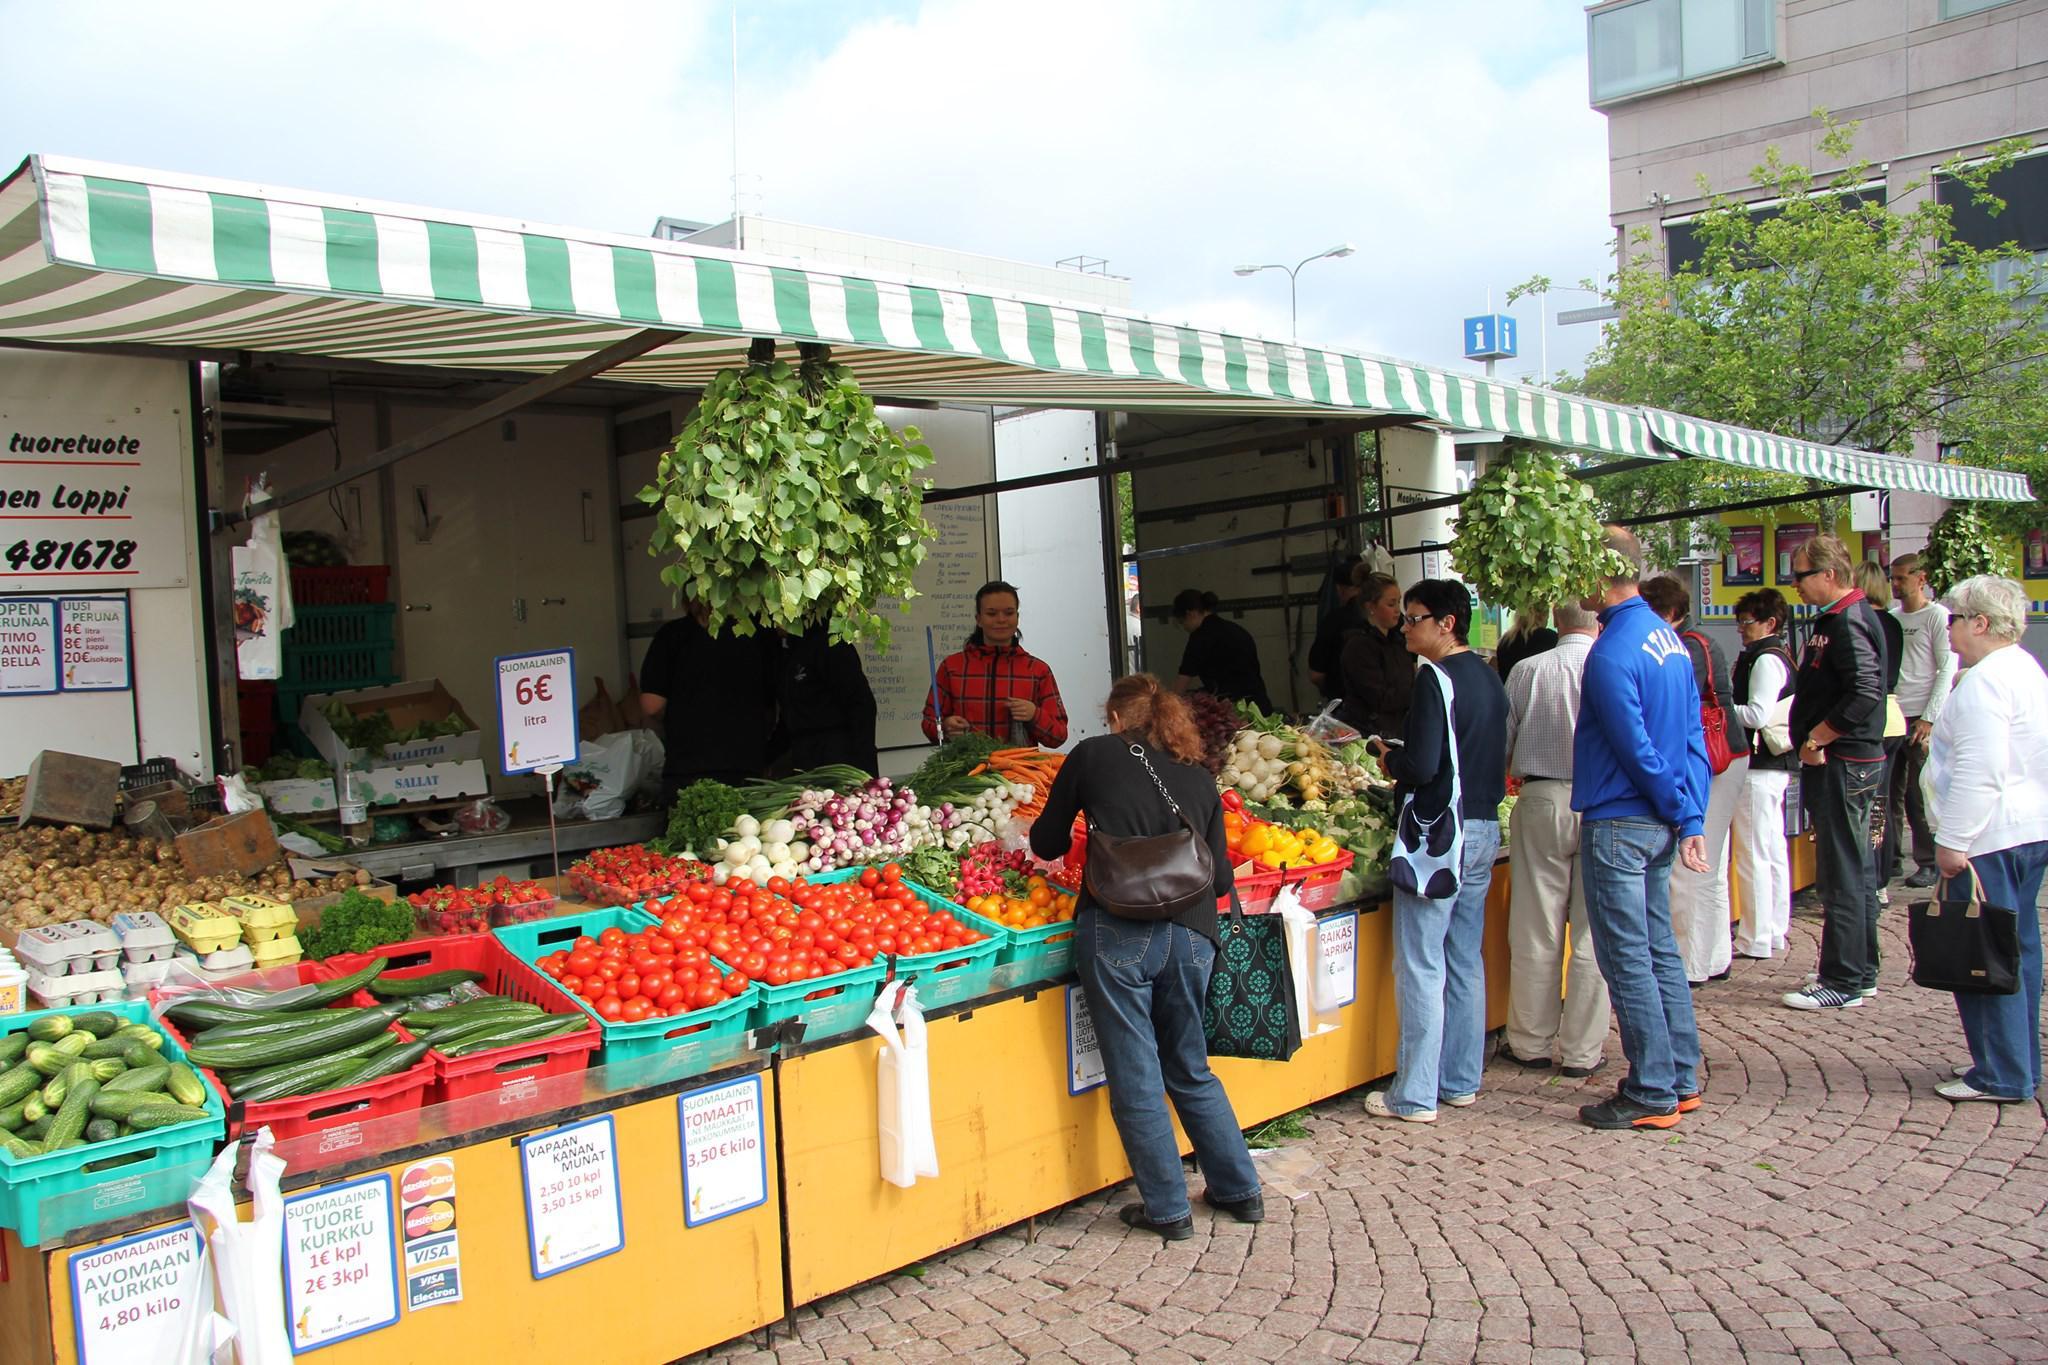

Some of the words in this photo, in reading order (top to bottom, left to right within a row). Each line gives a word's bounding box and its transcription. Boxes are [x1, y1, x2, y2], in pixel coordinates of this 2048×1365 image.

[9, 432, 140, 454] tuoretuote
[52, 484, 131, 515] Loppi
[5, 539, 138, 571] 481678
[63, 601, 91, 611] UUSI
[72, 612, 120, 621] PERUNA
[63, 623, 82, 635] 4€
[64, 637, 82, 649] 8€
[1, 657, 41, 667] BELLA
[500, 656, 567, 674] SUOMALAINEN
[515, 674, 553, 706] 6€
[524, 715, 547, 727] litra
[1324, 941, 1353, 957] APRIKA
[684, 1085, 753, 1112] SUOMALAINEN
[685, 1099, 754, 1129] TOMAATTI
[529, 1135, 578, 1158] VAPAAN
[553, 1142, 594, 1163] KANAN
[688, 1146, 718, 1168] 3,50
[720, 1143, 728, 1157] €
[730, 1137, 756, 1154] kilo
[562, 1150, 606, 1172] MUNAT
[403, 1174, 453, 1194] MasterCard
[540, 1181, 564, 1198] 2,50
[568, 1175, 580, 1188] 10
[583, 1168, 601, 1183] kpl
[287, 1188, 381, 1219] SUOMALAINEN
[541, 1197, 566, 1214] 3,50
[570, 1191, 583, 1205] 15
[585, 1185, 602, 1199] kpl
[303, 1205, 364, 1232] TUORE
[407, 1211, 453, 1229] MasterCard
[300, 1221, 374, 1253] KURKKU
[82, 1231, 190, 1271] SUOMALAINEN
[310, 1250, 330, 1269] 1€
[335, 1241, 361, 1263] kpl
[413, 1245, 449, 1264] VISA
[84, 1249, 191, 1294] AVOMAAN
[419, 1273, 445, 1287] VISA
[98, 1270, 178, 1306] KURKKU
[305, 1275, 327, 1294] 2€
[413, 1287, 456, 1305] Electron
[99, 1307, 140, 1331] 4,80
[146, 1297, 181, 1317] kilo
